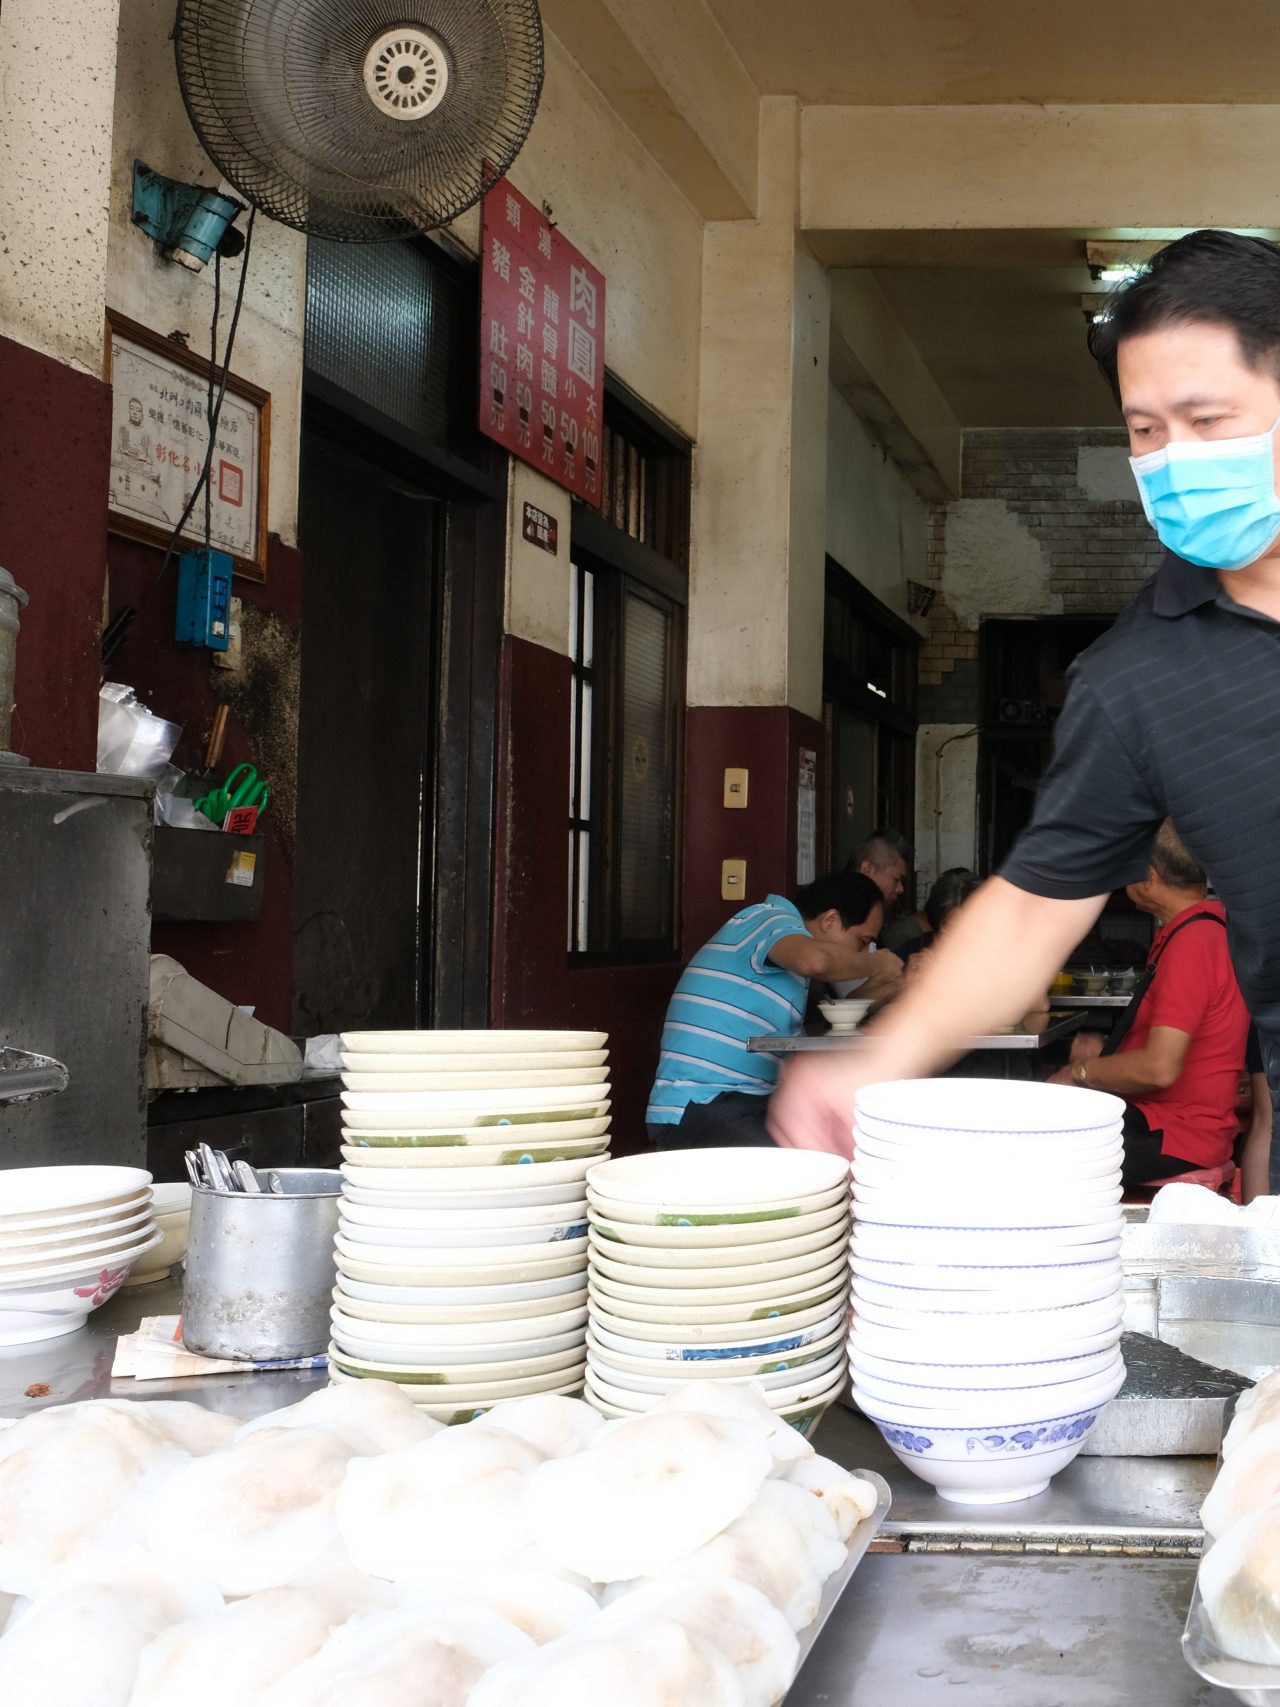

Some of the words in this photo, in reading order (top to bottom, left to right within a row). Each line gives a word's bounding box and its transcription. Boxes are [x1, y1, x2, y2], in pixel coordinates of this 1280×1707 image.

[505, 193, 521, 232] 類
[538, 225, 552, 261] 湯
[569, 264, 597, 390] 肉圓
